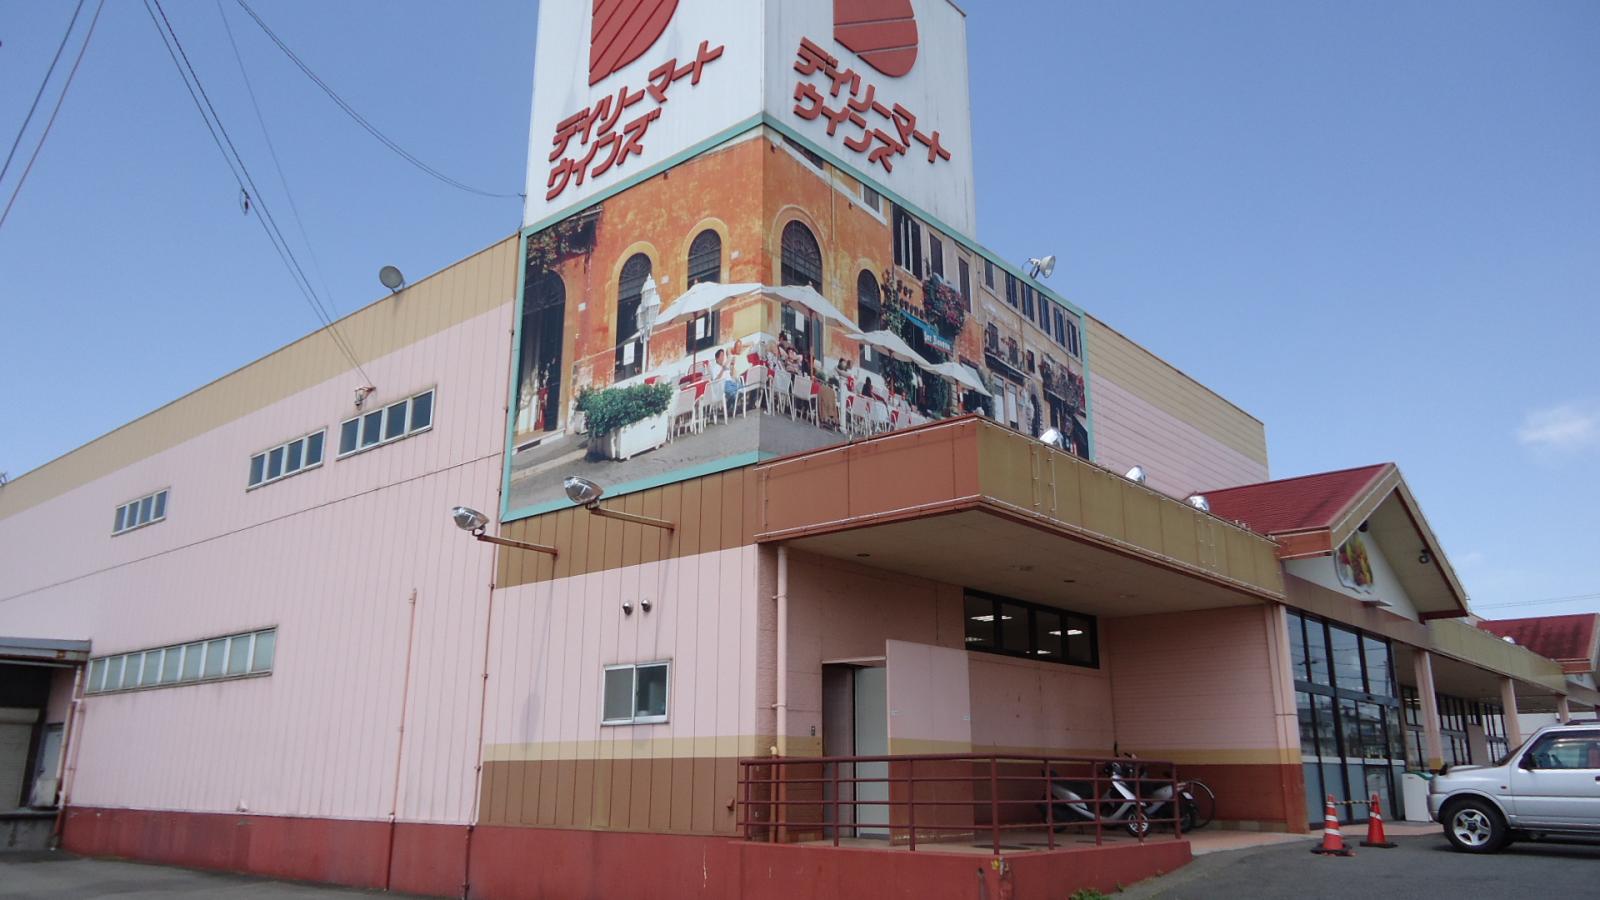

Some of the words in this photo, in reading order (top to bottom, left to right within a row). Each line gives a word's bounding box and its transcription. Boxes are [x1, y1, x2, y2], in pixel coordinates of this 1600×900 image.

[549, 40, 725, 162] デイリーマート
[793, 36, 951, 163] デイリーマート
[793, 81, 906, 173] ウインズ
[546, 107, 662, 201] ウインズ
